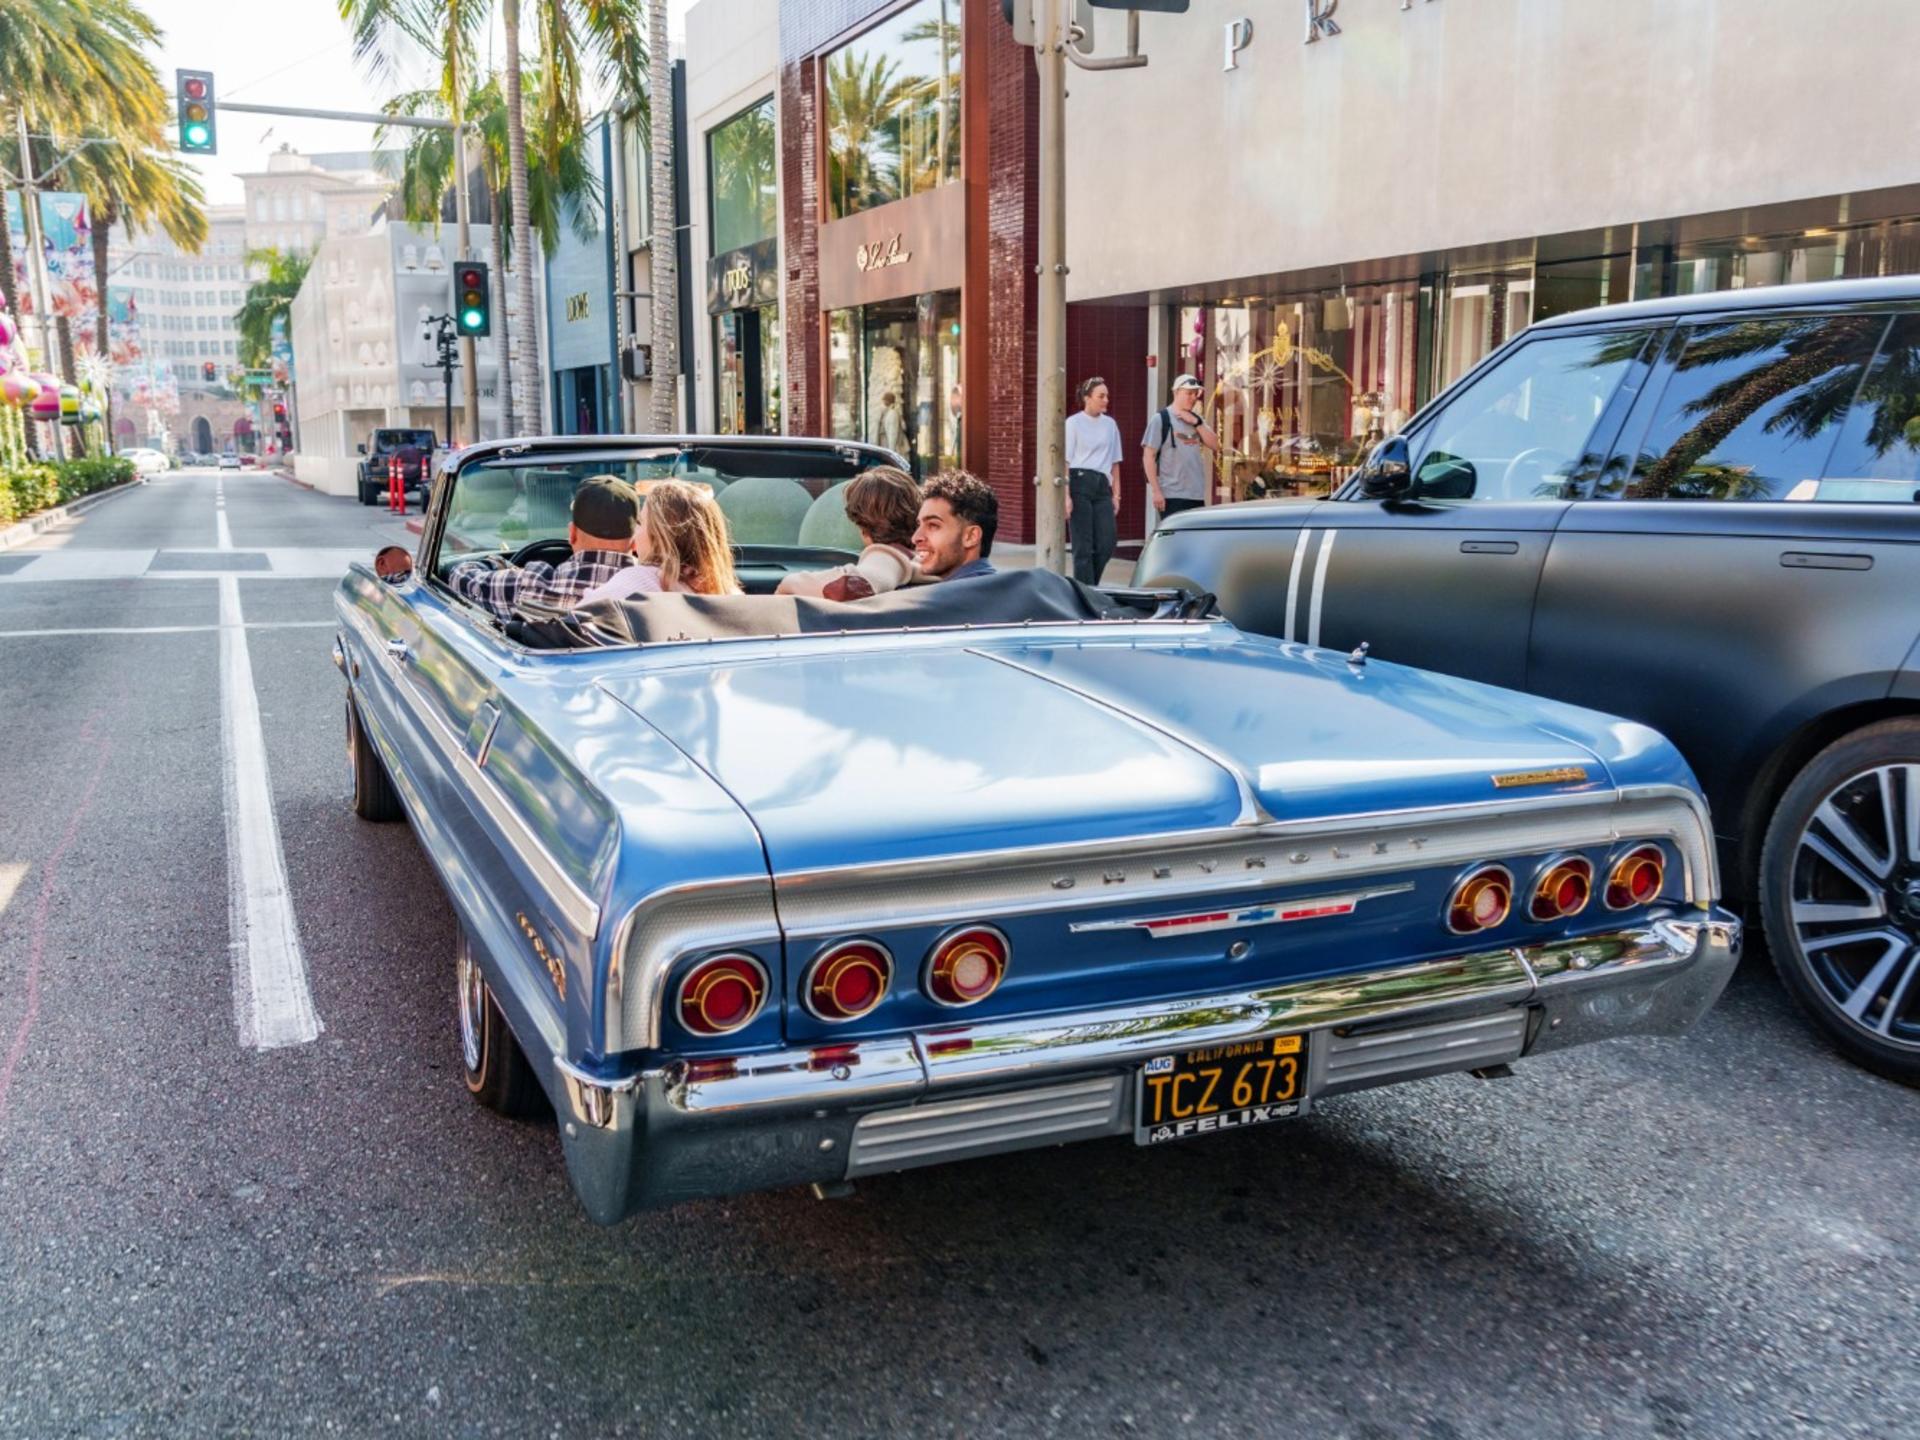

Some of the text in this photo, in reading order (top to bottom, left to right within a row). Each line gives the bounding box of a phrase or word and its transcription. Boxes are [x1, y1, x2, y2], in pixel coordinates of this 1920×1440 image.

[1051, 837, 1428, 890] CHEVROLET
[1146, 1058, 1171, 1071] AUG
[1187, 1040, 1265, 1064] CALIFORNIA
[1147, 1056, 1298, 1122] TCZ 673
[1176, 1106, 1271, 1136] FELIX
